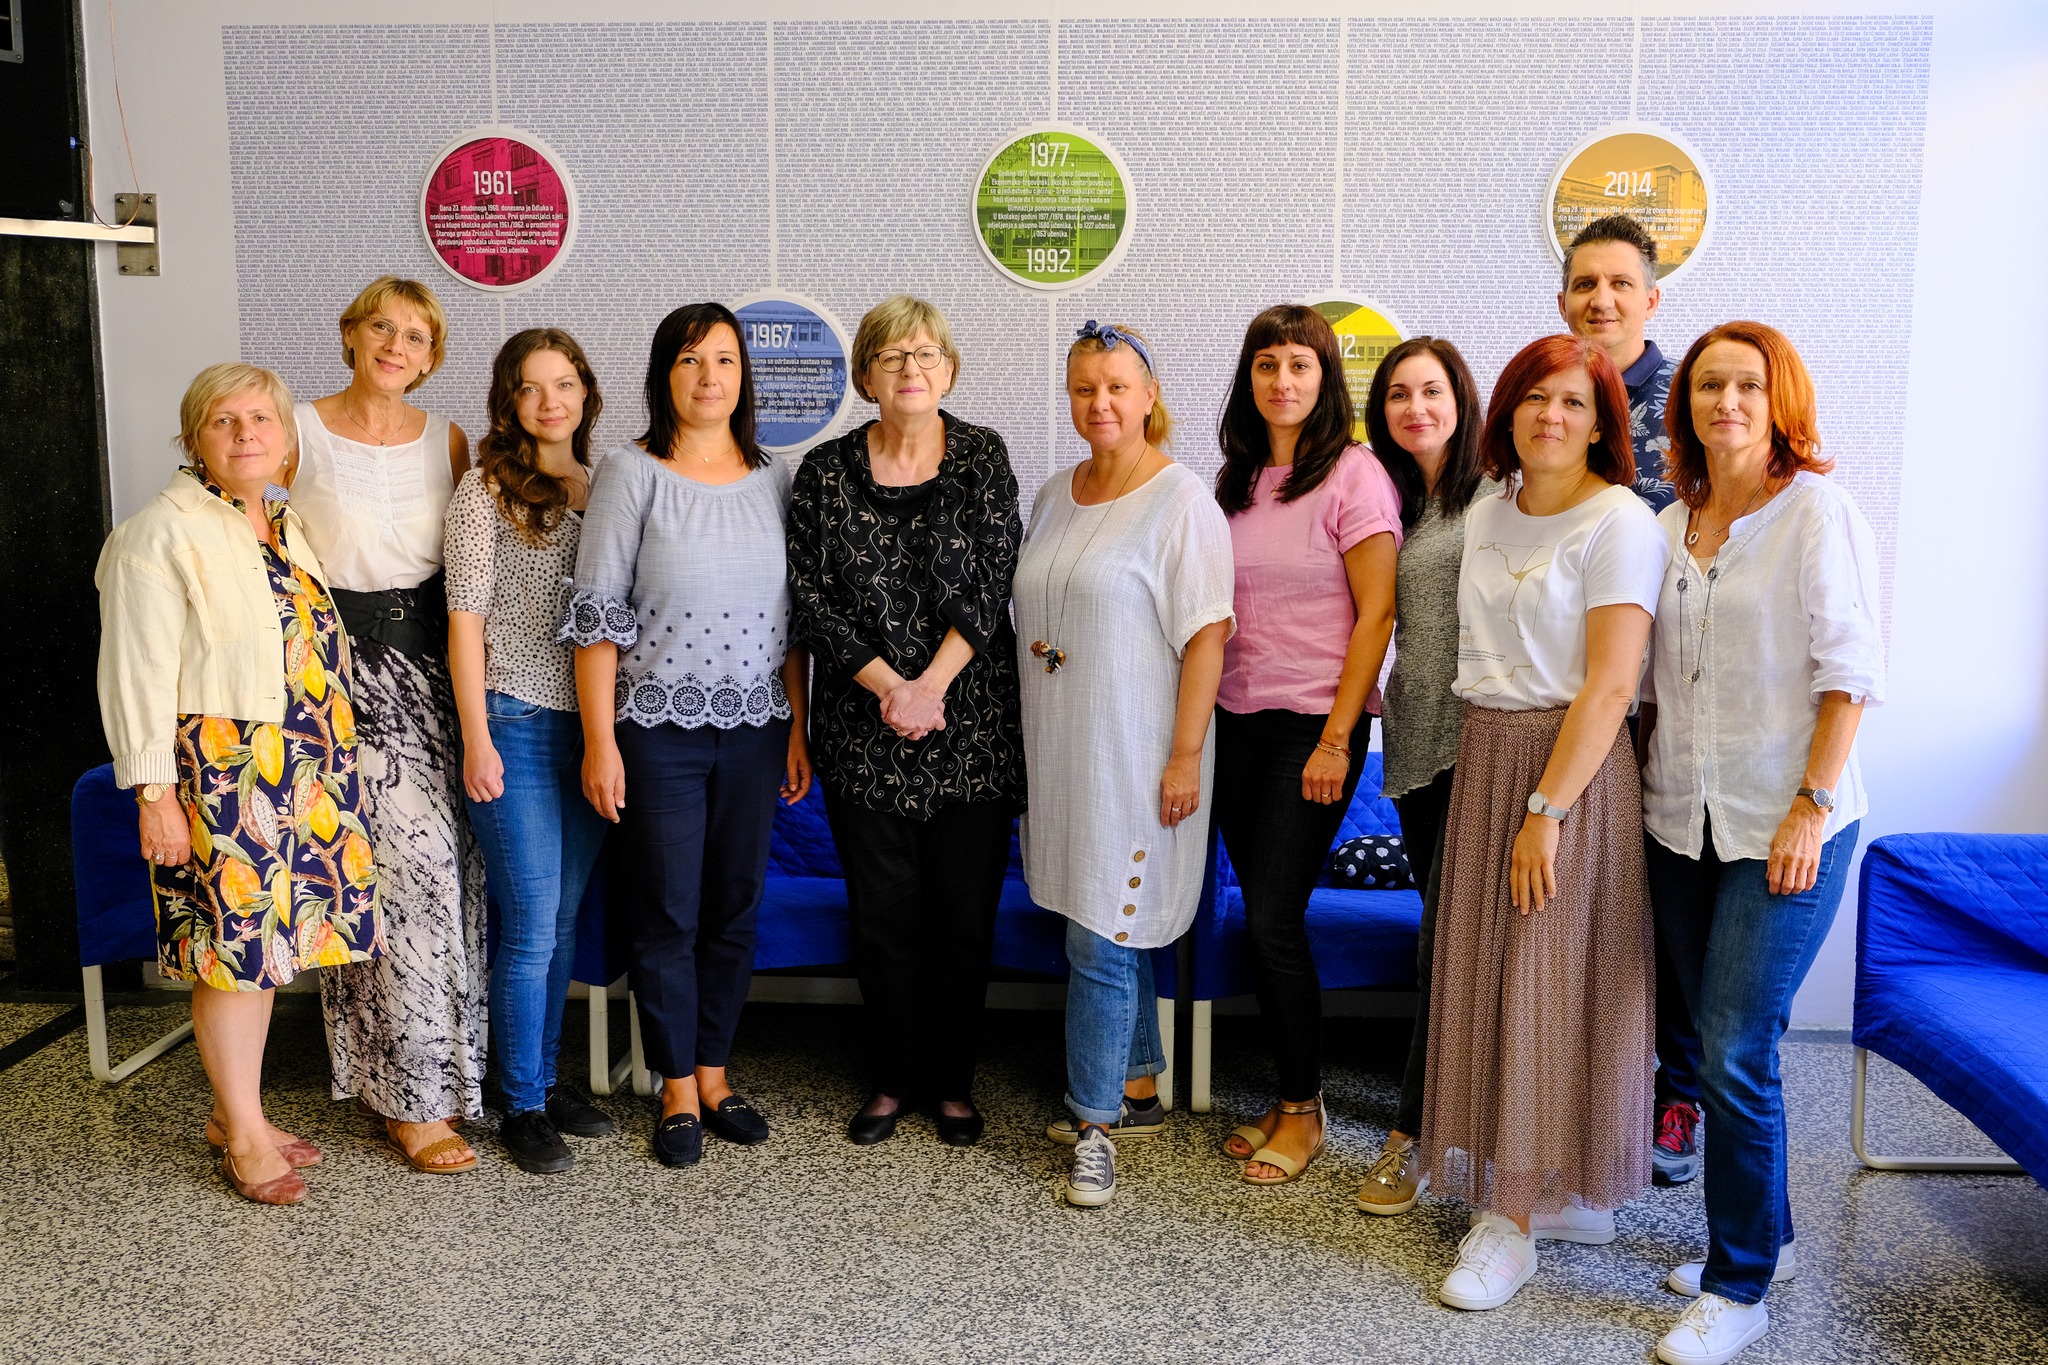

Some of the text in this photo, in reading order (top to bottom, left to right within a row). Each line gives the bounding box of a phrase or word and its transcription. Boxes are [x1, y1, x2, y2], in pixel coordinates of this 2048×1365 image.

[1030, 142, 1075, 168] 1977.
[473, 170, 519, 195] 1961.
[1604, 171, 1657, 197] 2014.
[1026, 248, 1076, 273] 1992.
[751, 324, 798, 349] 1967.
[1338, 334, 1360, 358] 12.
